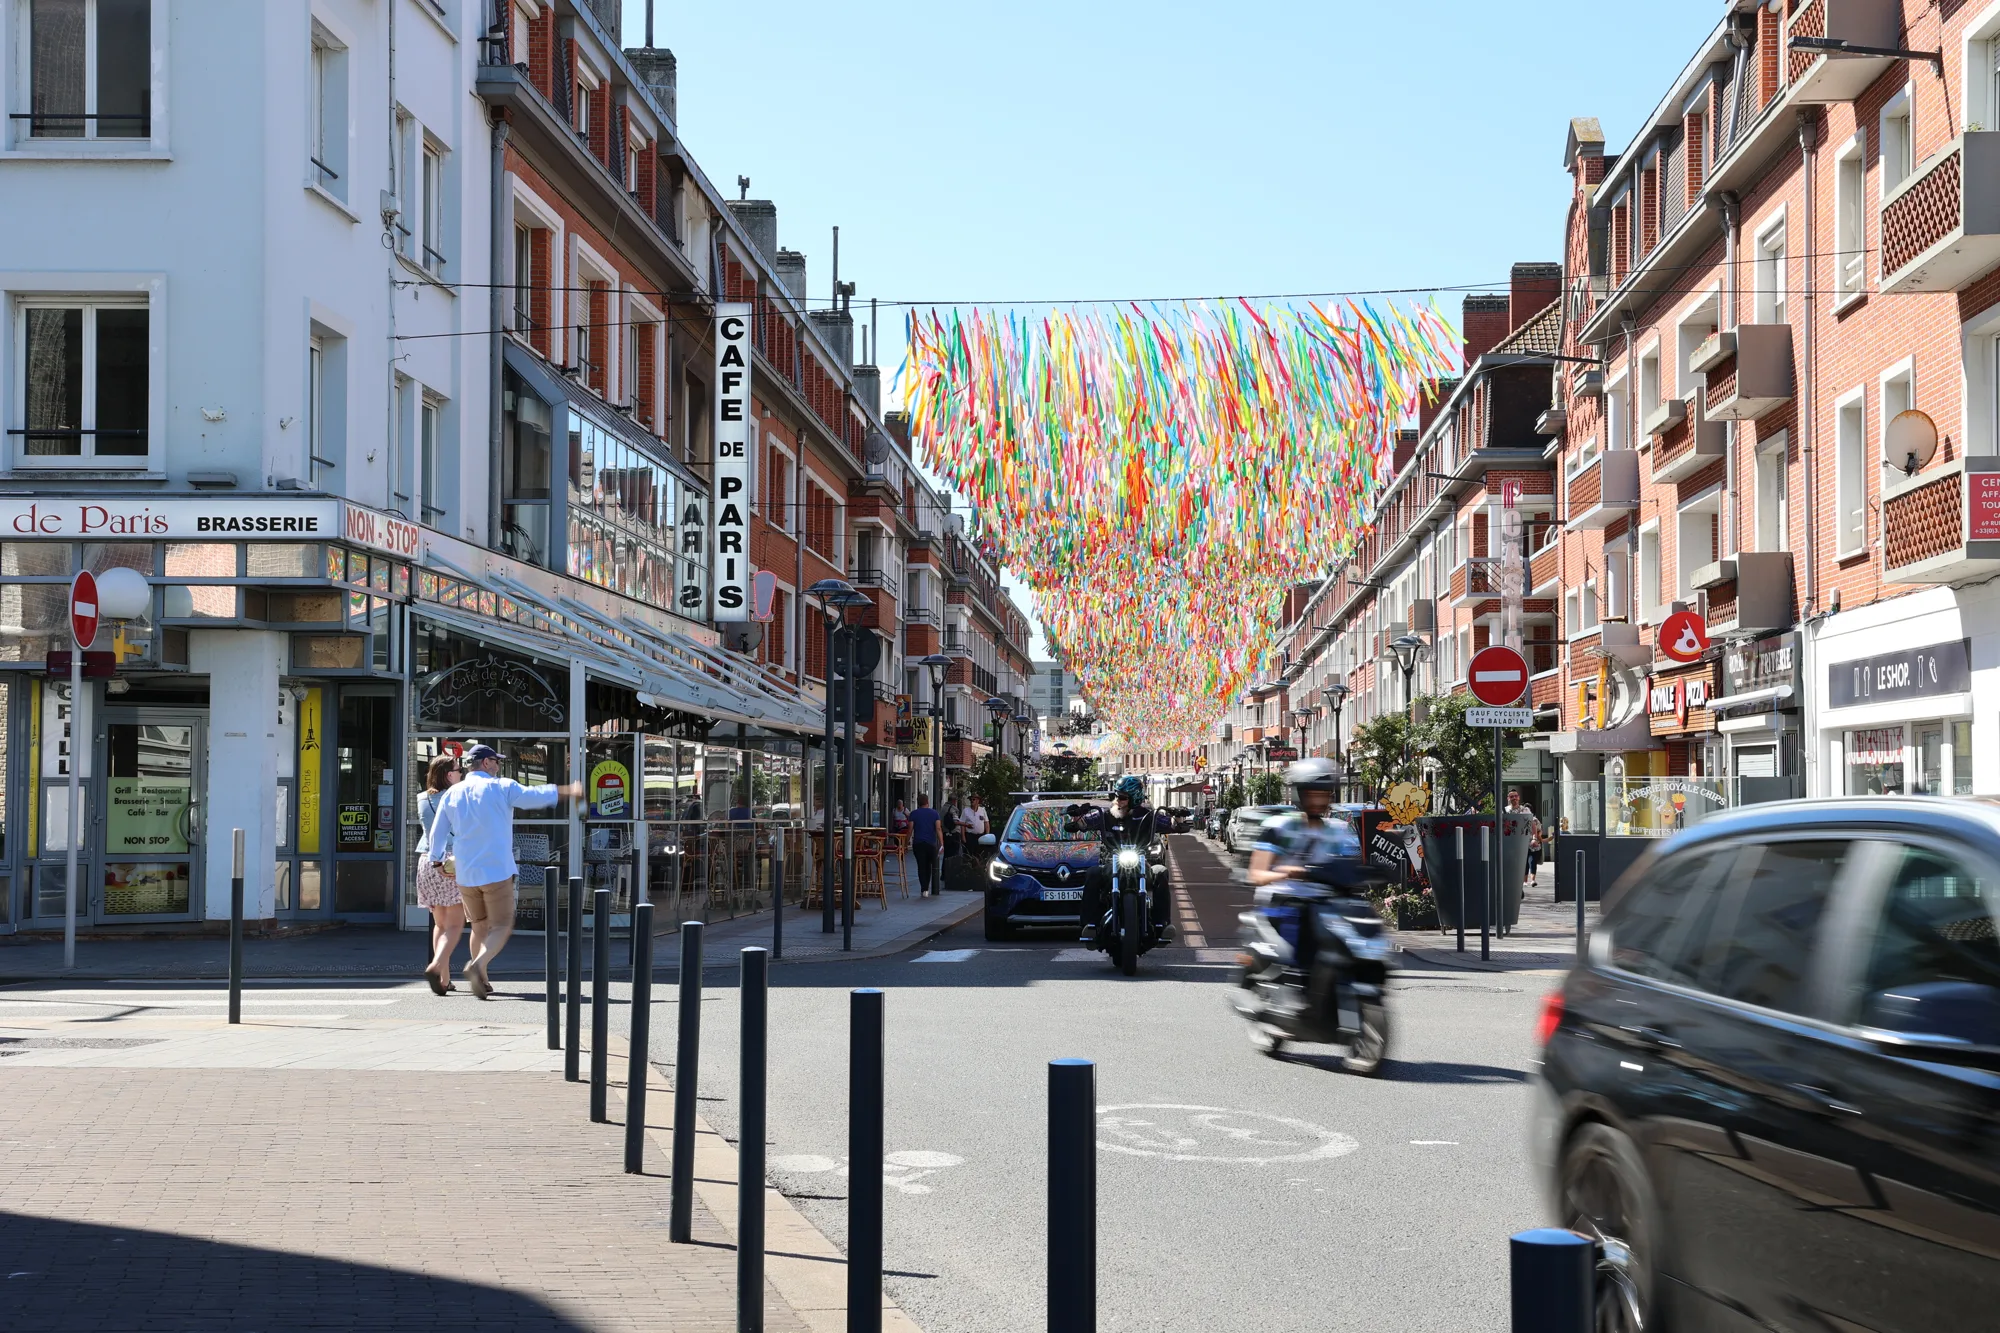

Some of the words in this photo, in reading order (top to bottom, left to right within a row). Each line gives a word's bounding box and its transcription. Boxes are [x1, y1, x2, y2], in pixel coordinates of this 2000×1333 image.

[719, 317, 745, 422] CAFE
[719, 441, 745, 457] DE
[13, 503, 62, 533] de
[78, 505, 169, 534] Paris
[197, 516, 318, 531] BRASSERIE
[346, 506, 375, 544] NON
[386, 519, 418, 556] STOP
[718, 476, 744, 609] PARIS
[451, 668, 478, 690] Café
[481, 668, 497, 680] de
[500, 670, 529, 691] Paris
[1877, 666, 1886, 690] LE
[1650, 685, 1675, 713] ROYALE
[1685, 679, 1705, 707] PIZZA
[1494, 710, 1530, 718] CYCLISTE
[142, 786, 182, 794] Restaurant
[301, 769, 311, 794] Paris
[114, 797, 150, 805] Brasserie
[160, 797, 182, 805] Snack
[301, 796, 311, 809] de
[1663, 782, 1699, 794] ROYALE
[1700, 787, 1727, 806] CHIPS
[127, 808, 146, 816] Café
[156, 808, 169, 816] Bar
[124, 836, 146, 845] NON
[149, 836, 170, 845] STOP
[1371, 834, 1405, 860] FRITES
[1371, 850, 1398, 871] maison
